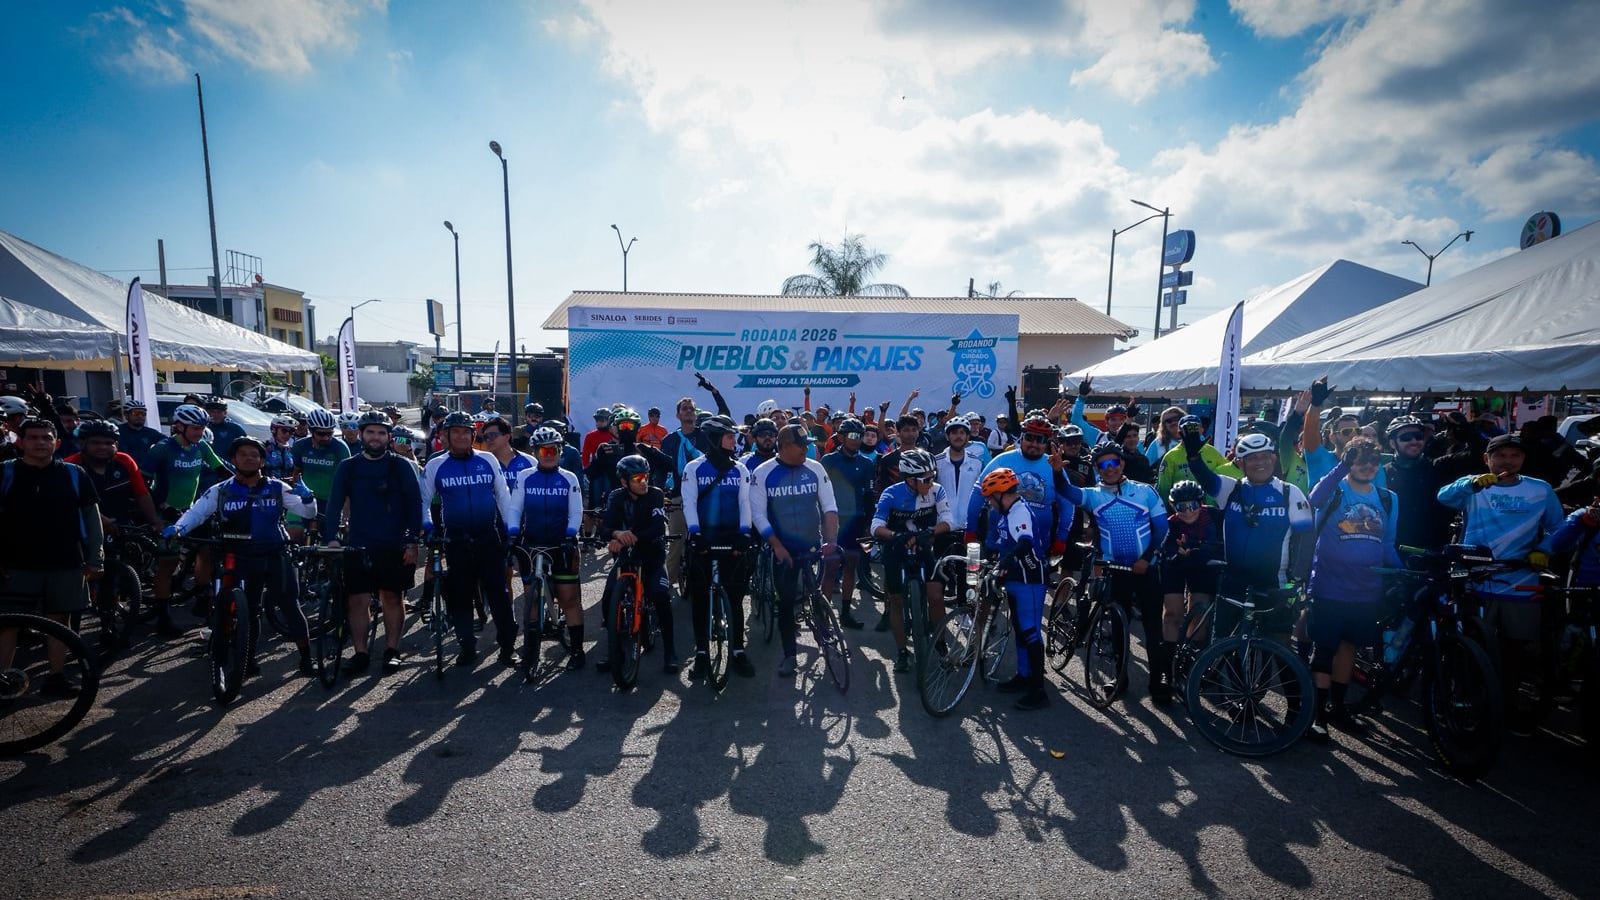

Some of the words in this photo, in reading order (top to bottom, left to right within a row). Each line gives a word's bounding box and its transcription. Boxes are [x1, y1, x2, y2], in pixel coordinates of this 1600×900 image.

[590, 314, 628, 322] SINALOA
[740, 328, 797, 342] RODADA
[801, 328, 838, 342] 2026
[957, 339, 994, 349] RODANDO
[676, 345, 790, 371] PUEBLOS
[790, 350, 808, 371] &
[811, 345, 924, 371] PAISAJES
[957, 363, 992, 374] AGUA
[757, 377, 787, 385] RUMBO
[788, 377, 799, 385] AL
[800, 377, 849, 386] TAMARINDO
[698, 476, 741, 486] NAVLATO
[767, 482, 818, 497] NAVOLATO
[1230, 501, 1286, 517] NAATO
